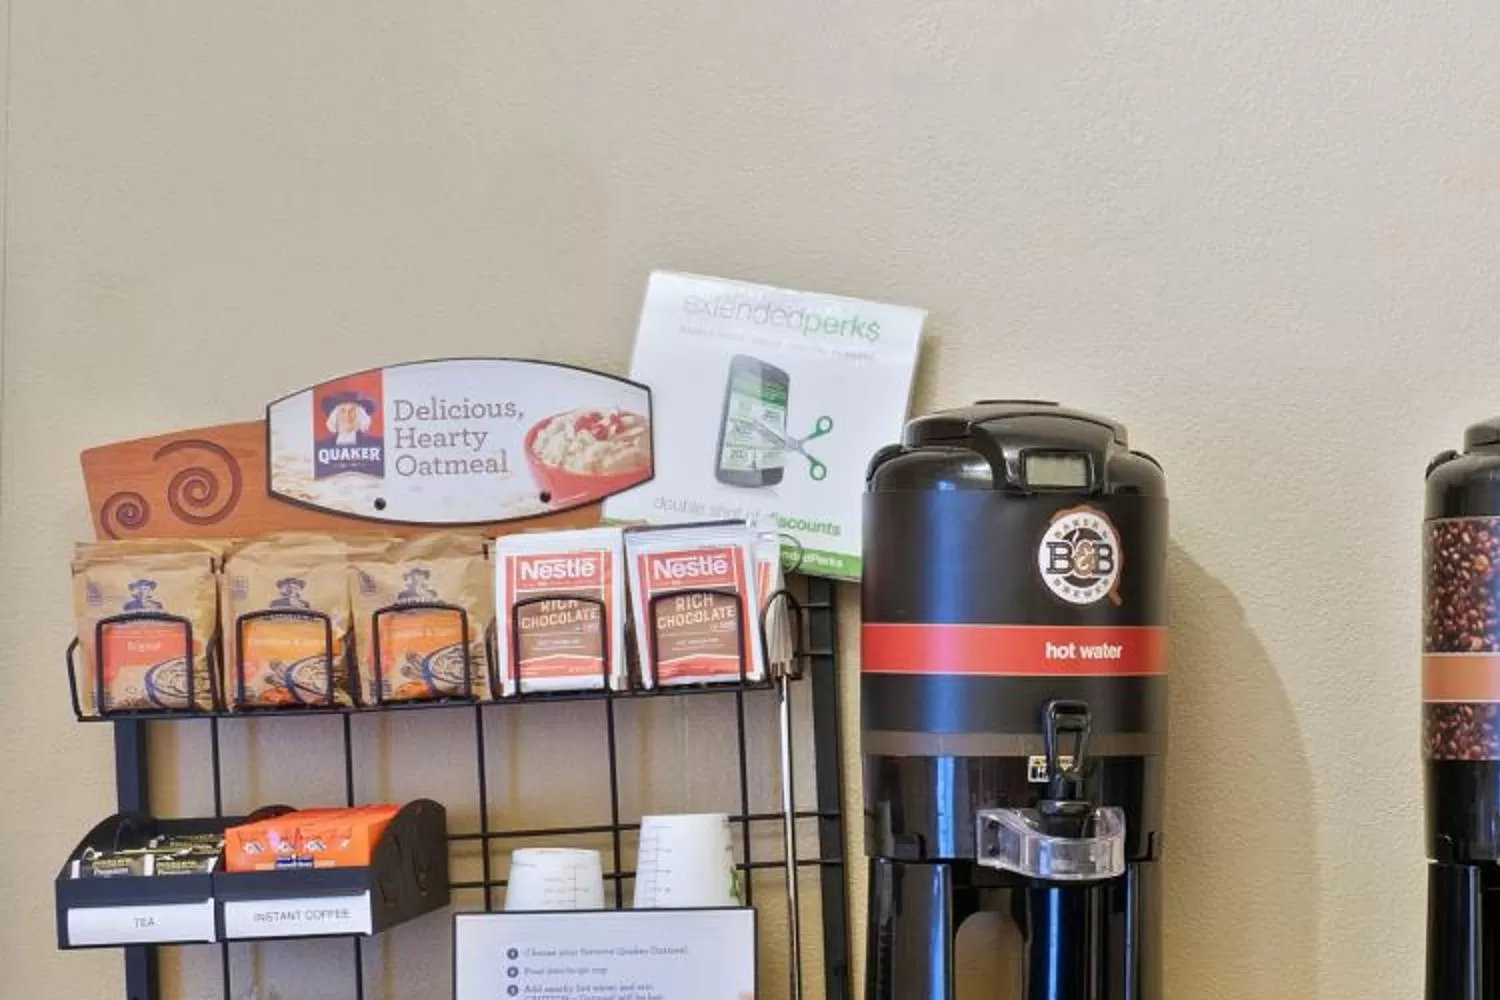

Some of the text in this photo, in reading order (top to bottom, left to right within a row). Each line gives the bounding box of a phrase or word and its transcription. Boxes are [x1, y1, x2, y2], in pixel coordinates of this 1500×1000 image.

[394, 399, 525, 421] Delicious,
[394, 427, 489, 450] Hearty
[319, 447, 381, 464] QUAKER
[395, 449, 509, 477] Oatmeal
[1046, 540, 1114, 575] B&B
[675, 594, 714, 612] RICH
[521, 607, 600, 630] CHOCOLATE
[657, 606, 737, 630] CHOCOLATE
[1045, 642, 1123, 659] hot water
[134, 918, 155, 928] TEA
[254, 909, 351, 922] INSTANT COFFEE
